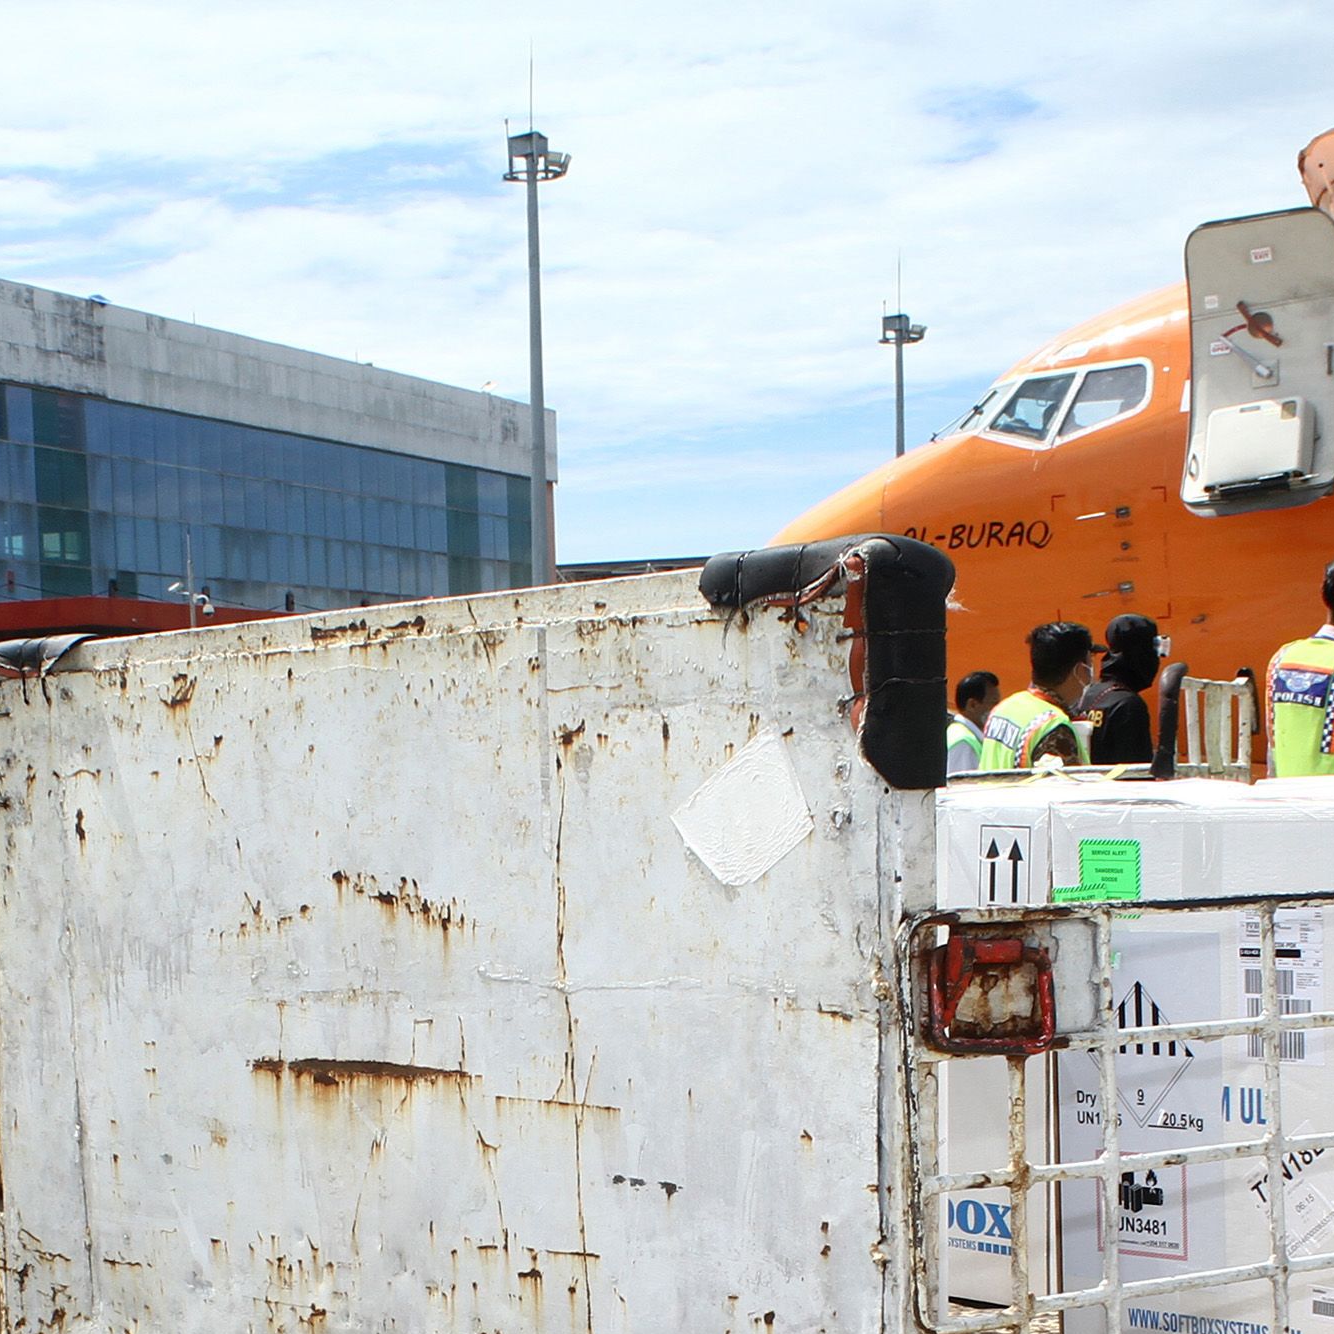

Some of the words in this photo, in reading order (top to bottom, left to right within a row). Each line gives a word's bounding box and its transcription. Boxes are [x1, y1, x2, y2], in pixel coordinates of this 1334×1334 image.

[1273, 692, 1322, 707] POLISI
[1076, 1090, 1096, 1107] Dry
[1137, 1088, 1144, 1101] 9
[1077, 1111, 1123, 1126] UN15
[1295, 1193, 1315, 1213] 06:15
